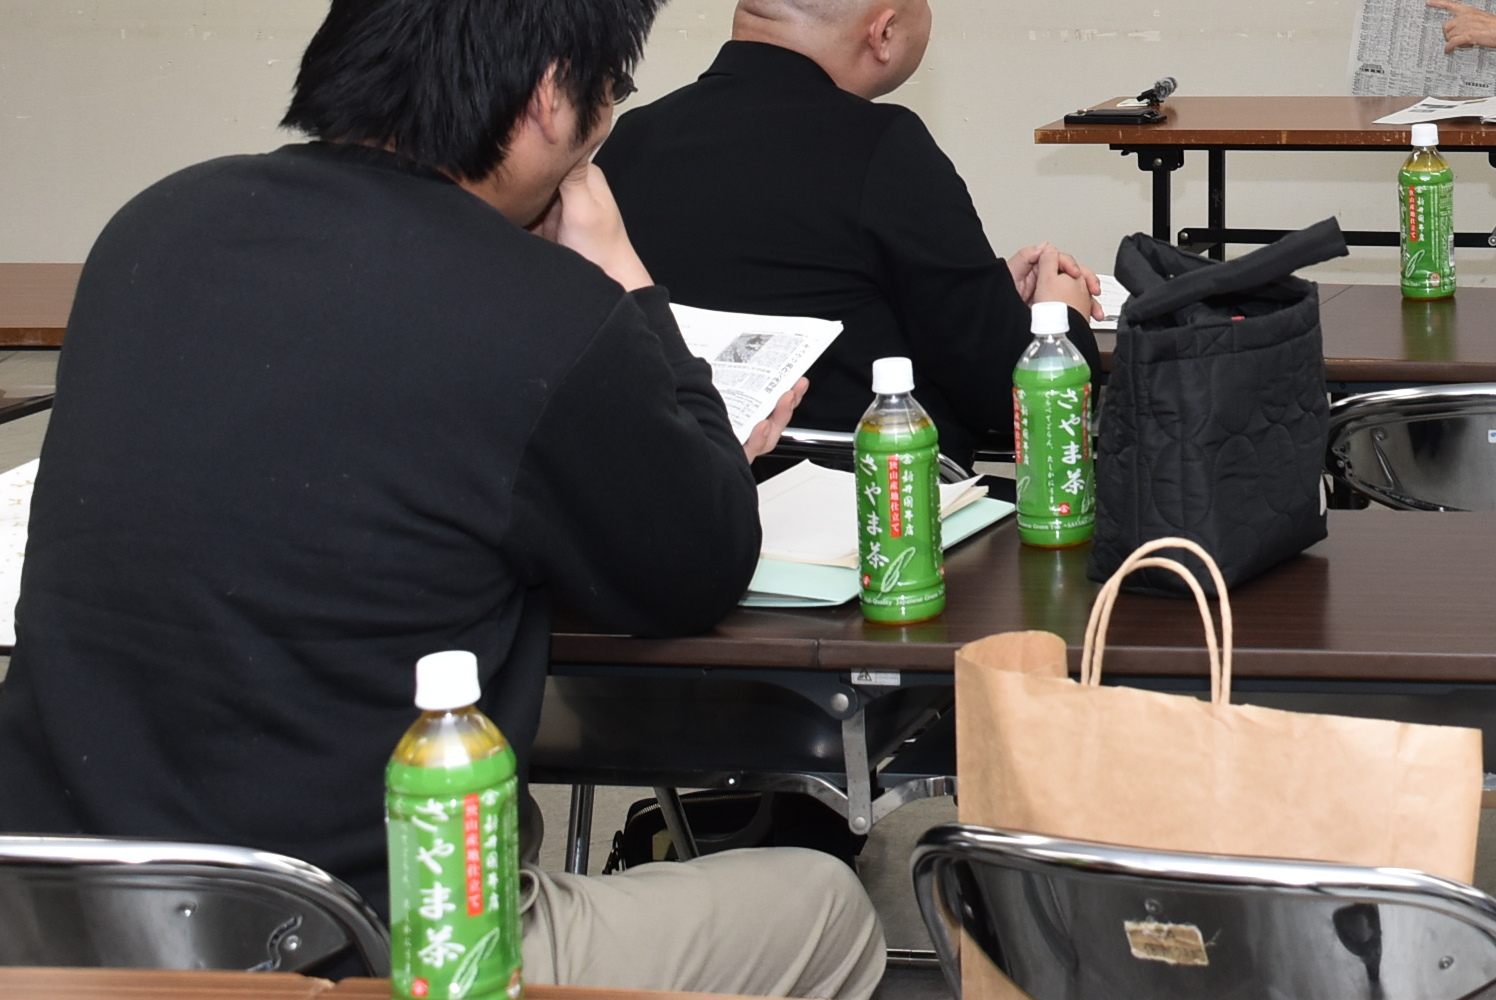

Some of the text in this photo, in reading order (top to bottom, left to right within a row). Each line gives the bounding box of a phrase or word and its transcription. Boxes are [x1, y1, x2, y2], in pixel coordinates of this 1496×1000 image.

[1057, 388, 1085, 495] さやま茶
[860, 453, 890, 569] さやま茶
[412, 798, 466, 969] さやま茶
